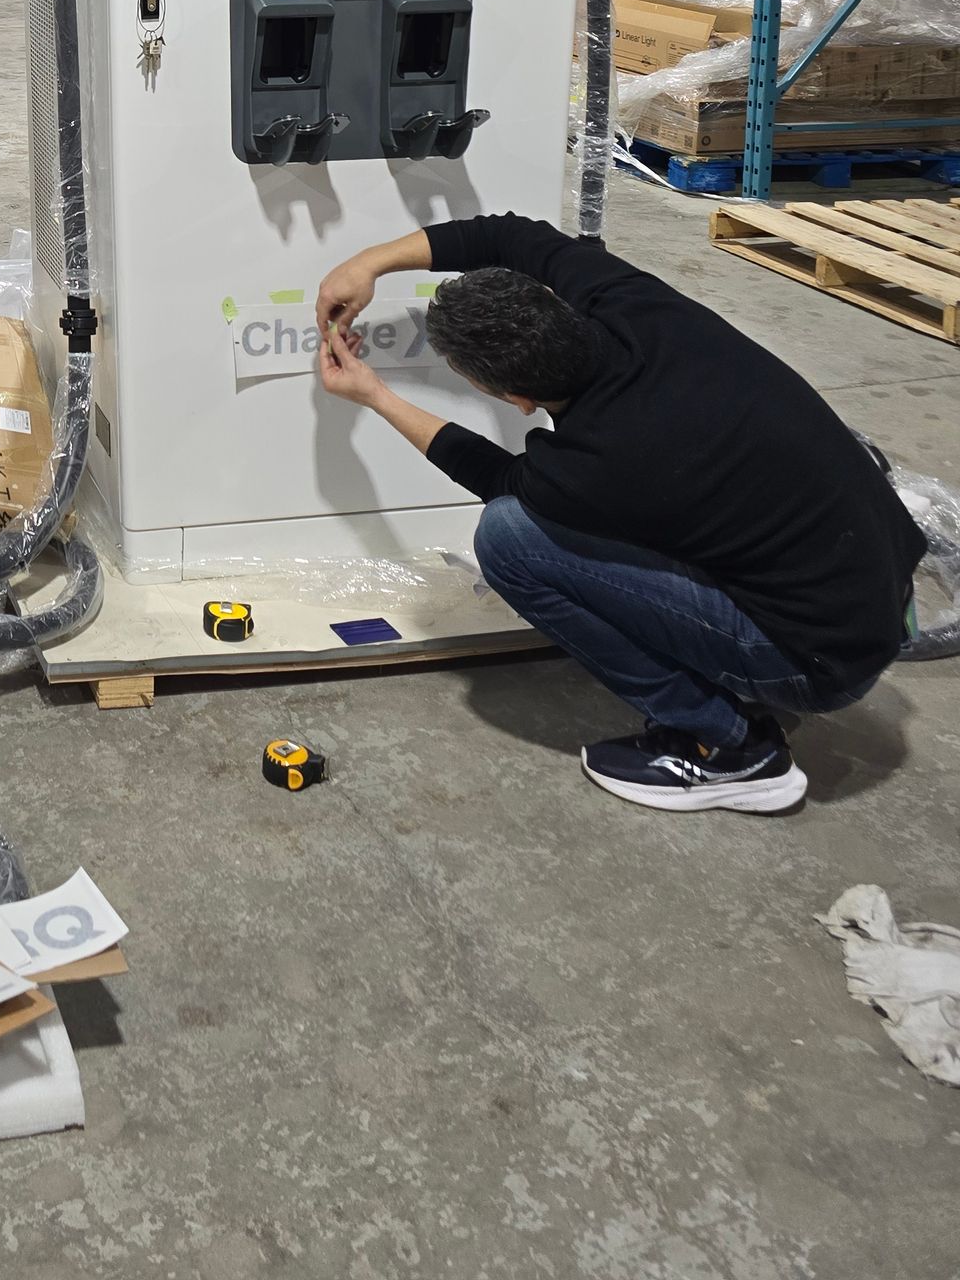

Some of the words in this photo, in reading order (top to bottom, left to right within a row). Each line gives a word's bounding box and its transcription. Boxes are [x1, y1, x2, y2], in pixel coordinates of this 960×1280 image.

[622, 30, 640, 42] Linear
[641, 35, 657, 48] Light
[241, 318, 397, 360] Chage
